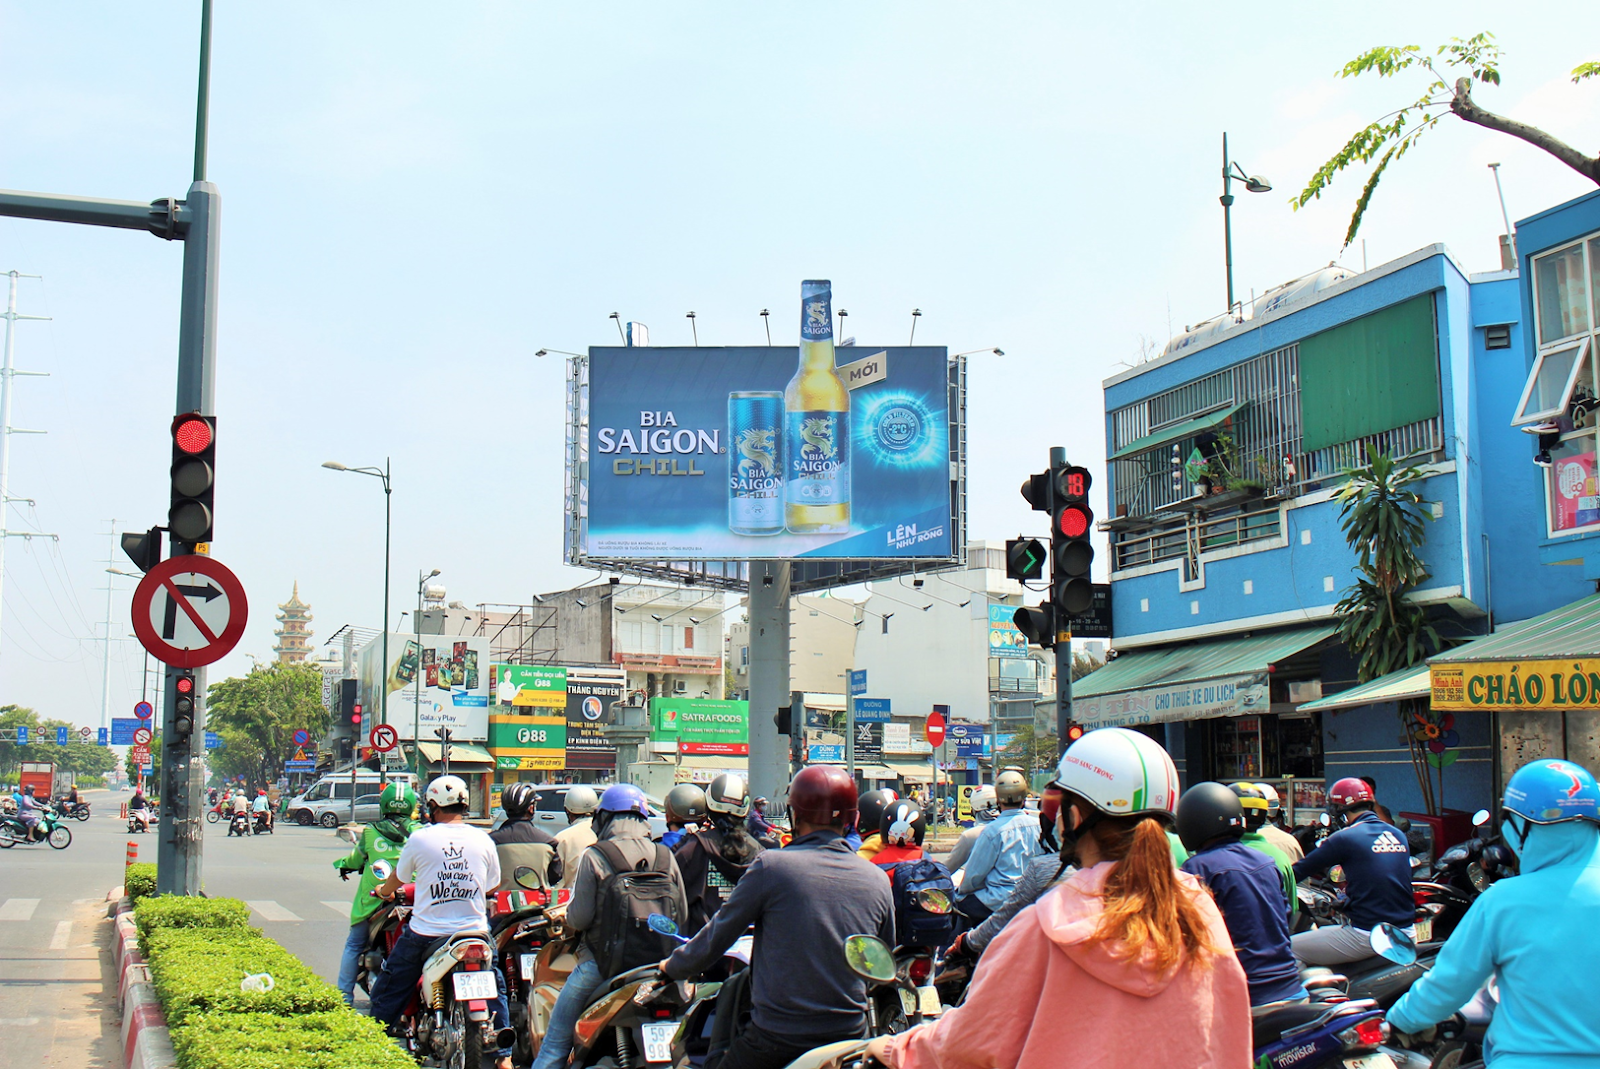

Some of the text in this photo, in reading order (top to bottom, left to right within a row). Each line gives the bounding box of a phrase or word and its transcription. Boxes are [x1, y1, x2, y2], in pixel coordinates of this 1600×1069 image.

[803, 326, 832, 335] SAIGON
[849, 361, 878, 382] MỚI
[640, 410, 677, 427] BIA
[598, 428, 720, 454] SAIGON
[808, 453, 825, 461] BIA
[613, 458, 706, 476] CHILL
[793, 460, 841, 472] SAIGON
[748, 469, 766, 478] BIA
[730, 476, 784, 490] SAIGON
[1067, 472, 1084, 496] 18
[736, 491, 778, 499] CHILL
[886, 523, 917, 544] LÊN
[896, 536, 917, 549] NHƯ
[1467, 664, 1546, 705] CHÁO
[1154, 683, 1236, 710] CHO THUÊ XE DU LỊCH
[420, 714, 456, 722] Galaxy Play
[862, 710, 878, 718] QUANG
[1102, 718, 1126, 727] TÙNG
[1138, 715, 1150, 724] TÔ
[518, 728, 547, 743] F88
[1080, 760, 1093, 770] SANG
[389, 800, 408, 808] Grab
[1371, 844, 1406, 853] adidas
[448, 859, 469, 870] can't
[453, 871, 474, 882] can't
[430, 881, 479, 899] We can!
[460, 975, 489, 986] 52-H9
[462, 986, 491, 998] 3105
[1279, 1042, 1316, 1068] movistar
